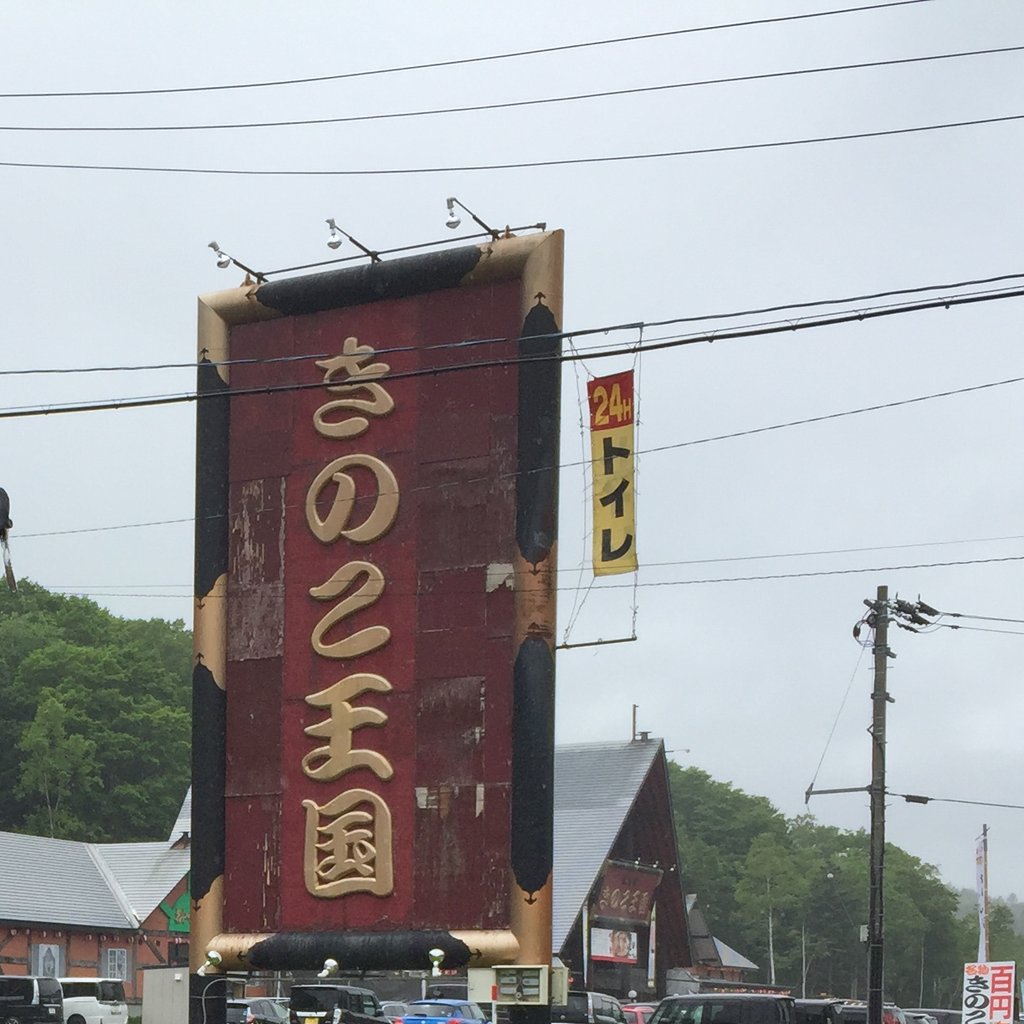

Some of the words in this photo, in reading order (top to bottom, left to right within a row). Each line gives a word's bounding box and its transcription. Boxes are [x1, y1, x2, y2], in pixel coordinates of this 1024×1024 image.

[592, 382, 632, 426] 24H
[599, 436, 633, 563] トイレ
[302, 336, 400, 898] きのこ王国
[989, 965, 1014, 1020] 百円
